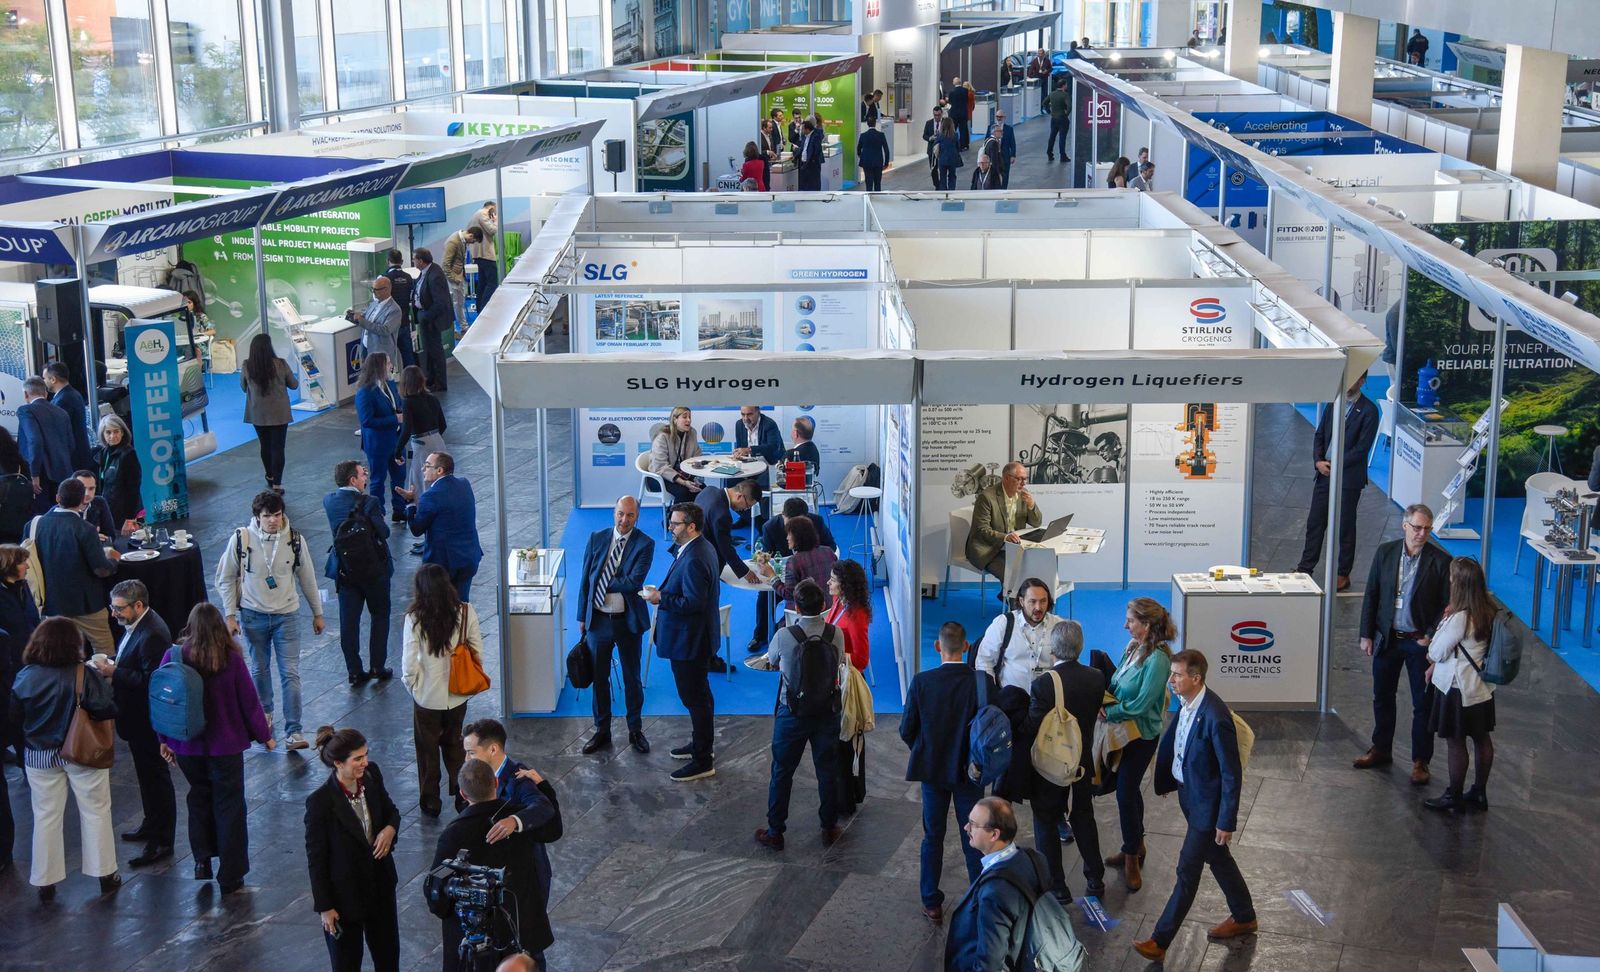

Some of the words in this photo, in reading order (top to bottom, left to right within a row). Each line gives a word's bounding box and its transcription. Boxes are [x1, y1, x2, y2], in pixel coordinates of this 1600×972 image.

[1244, 120, 1308, 132] Accelerating
[283, 224, 320, 234] MOBILITY
[321, 226, 360, 236] PROJECTS
[278, 239, 312, 249] PROJECT
[233, 252, 254, 261] FROM
[285, 255, 295, 263] TO
[583, 263, 628, 281] SLG
[792, 270, 820, 278] GREEN
[821, 269, 866, 278] HYDROGEN
[1181, 326, 1233, 334] STIRLING
[1181, 335, 1233, 343] CRYOGENICS
[1444, 343, 1479, 355] YOUR
[1436, 359, 1495, 370] RELIABLE
[626, 377, 669, 389] SLG
[676, 376, 780, 392] Hydrogen
[1020, 374, 1125, 388] Hydrogen
[1131, 373, 1244, 388] Liquefiers
[144, 369, 175, 486] COFFEE
[1220, 654, 1282, 664] STIRLING
[1220, 665, 1281, 674] CRYOGENICS
